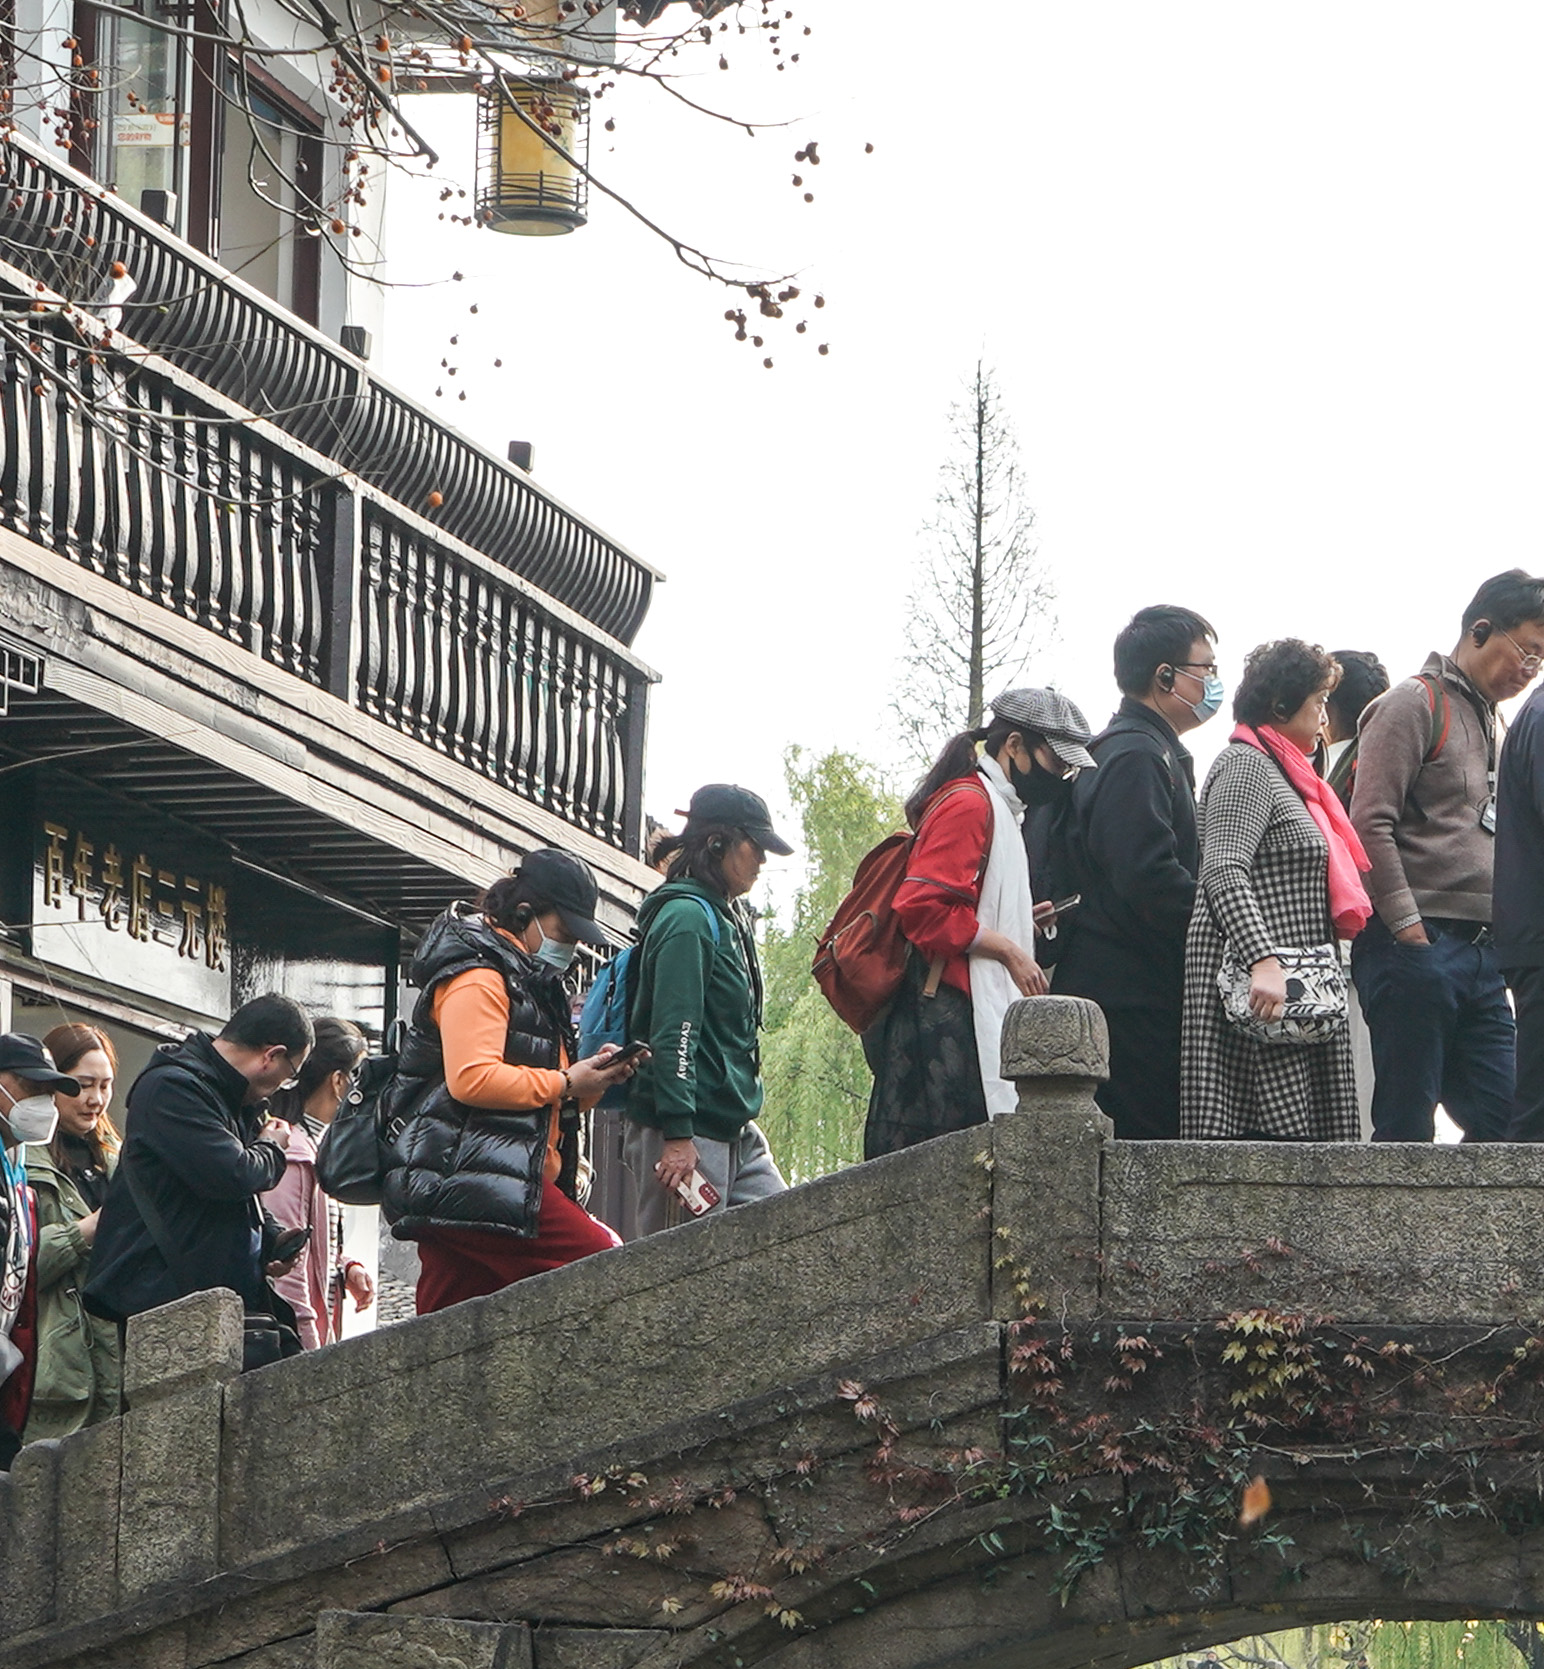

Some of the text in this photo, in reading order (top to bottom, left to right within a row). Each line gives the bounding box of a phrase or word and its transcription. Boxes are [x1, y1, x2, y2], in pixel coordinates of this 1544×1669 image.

[44, 821, 226, 972] 百年老店三元楼
